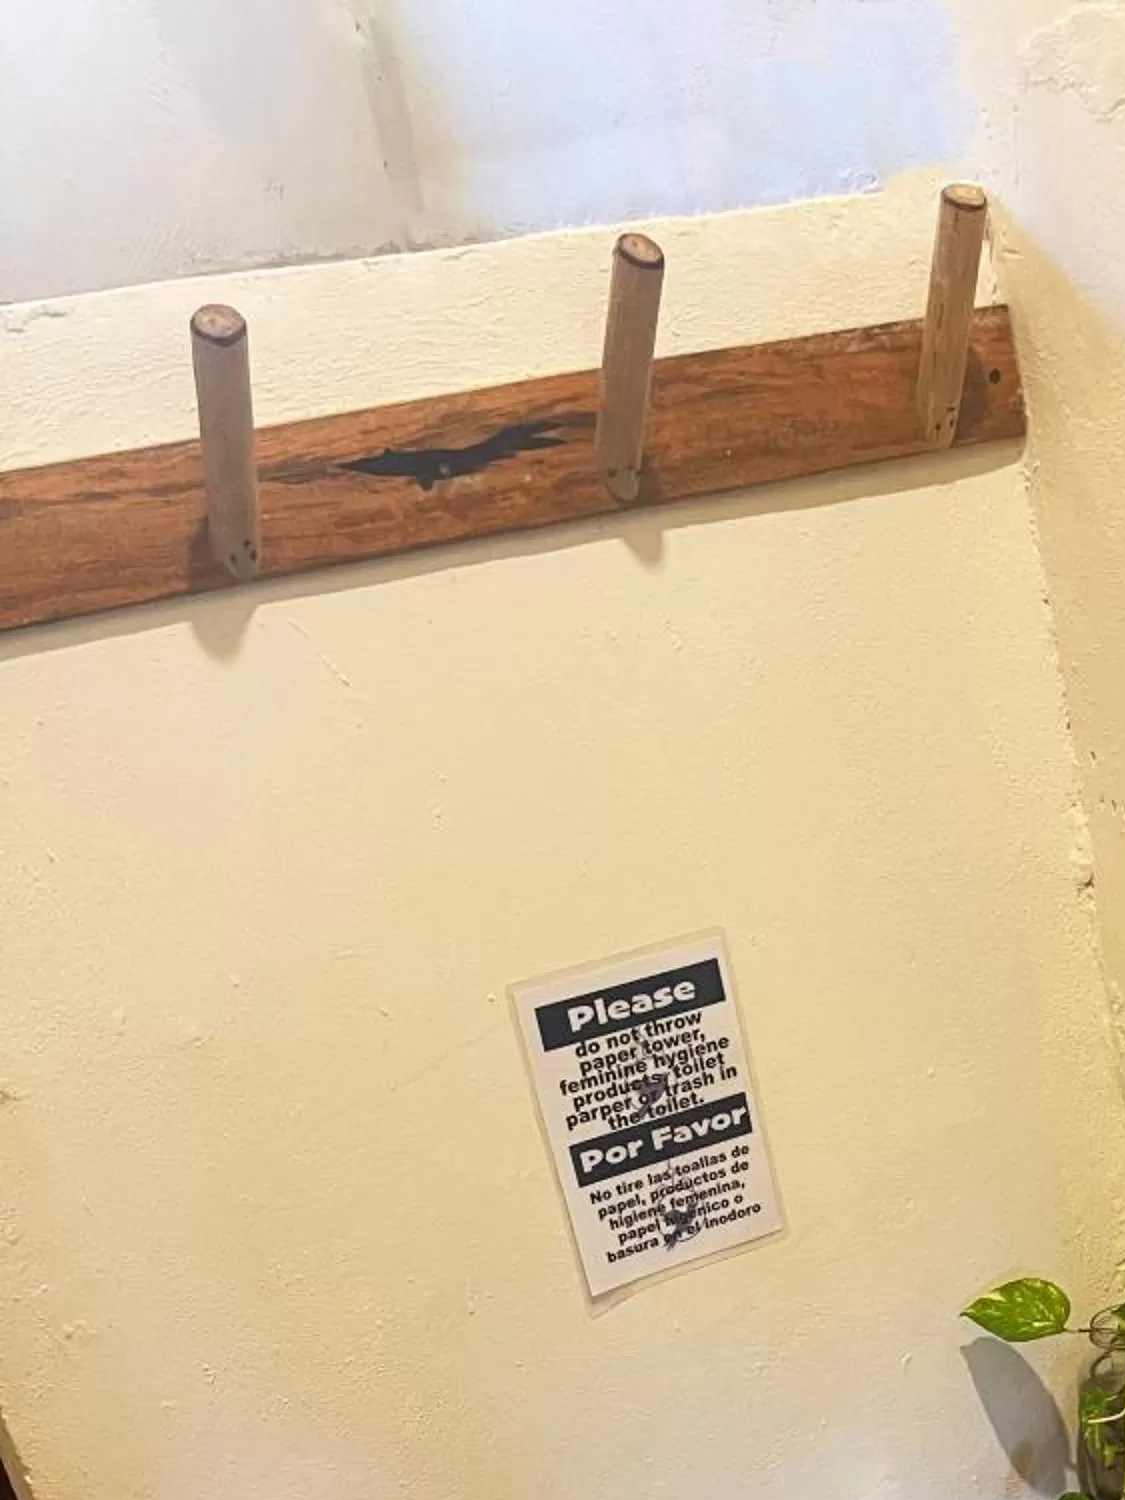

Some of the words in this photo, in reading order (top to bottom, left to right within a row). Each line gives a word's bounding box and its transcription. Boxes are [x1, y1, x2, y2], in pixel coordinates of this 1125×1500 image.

[567, 981, 696, 1032] Please
[575, 1039, 600, 1057] do
[607, 1029, 639, 1048] not
[645, 1011, 702, 1037] throw
[579, 1048, 636, 1077] paper
[644, 1029, 705, 1054] tower,
[560, 1061, 647, 1096] feminine
[653, 1037, 729, 1070] hygiene
[675, 1053, 726, 1078] toilet
[566, 1097, 632, 1130] parper
[665, 1072, 715, 1097] trash
[720, 1066, 737, 1081] in
[608, 1110, 644, 1130] the
[648, 1095, 704, 1119] toilet.
[579, 1139, 643, 1173] Por
[651, 1106, 747, 1151] Favor
[590, 1190, 612, 1204] No
[616, 1179, 644, 1195] tire
[647, 1170, 671, 1185] las
[676, 1151, 727, 1176] toallas
[731, 1145, 749, 1158] de
[598, 1195, 646, 1220] papel,
[650, 1166, 727, 1202] productos
[731, 1161, 749, 1174] de
[609, 1204, 666, 1229] higiene
[670, 1180, 745, 1207] femenina,
[618, 1220, 661, 1245] papel
[734, 1195, 743, 1204] o
[606, 1236, 659, 1263] basura
[705, 1203, 761, 1228] inodoro
